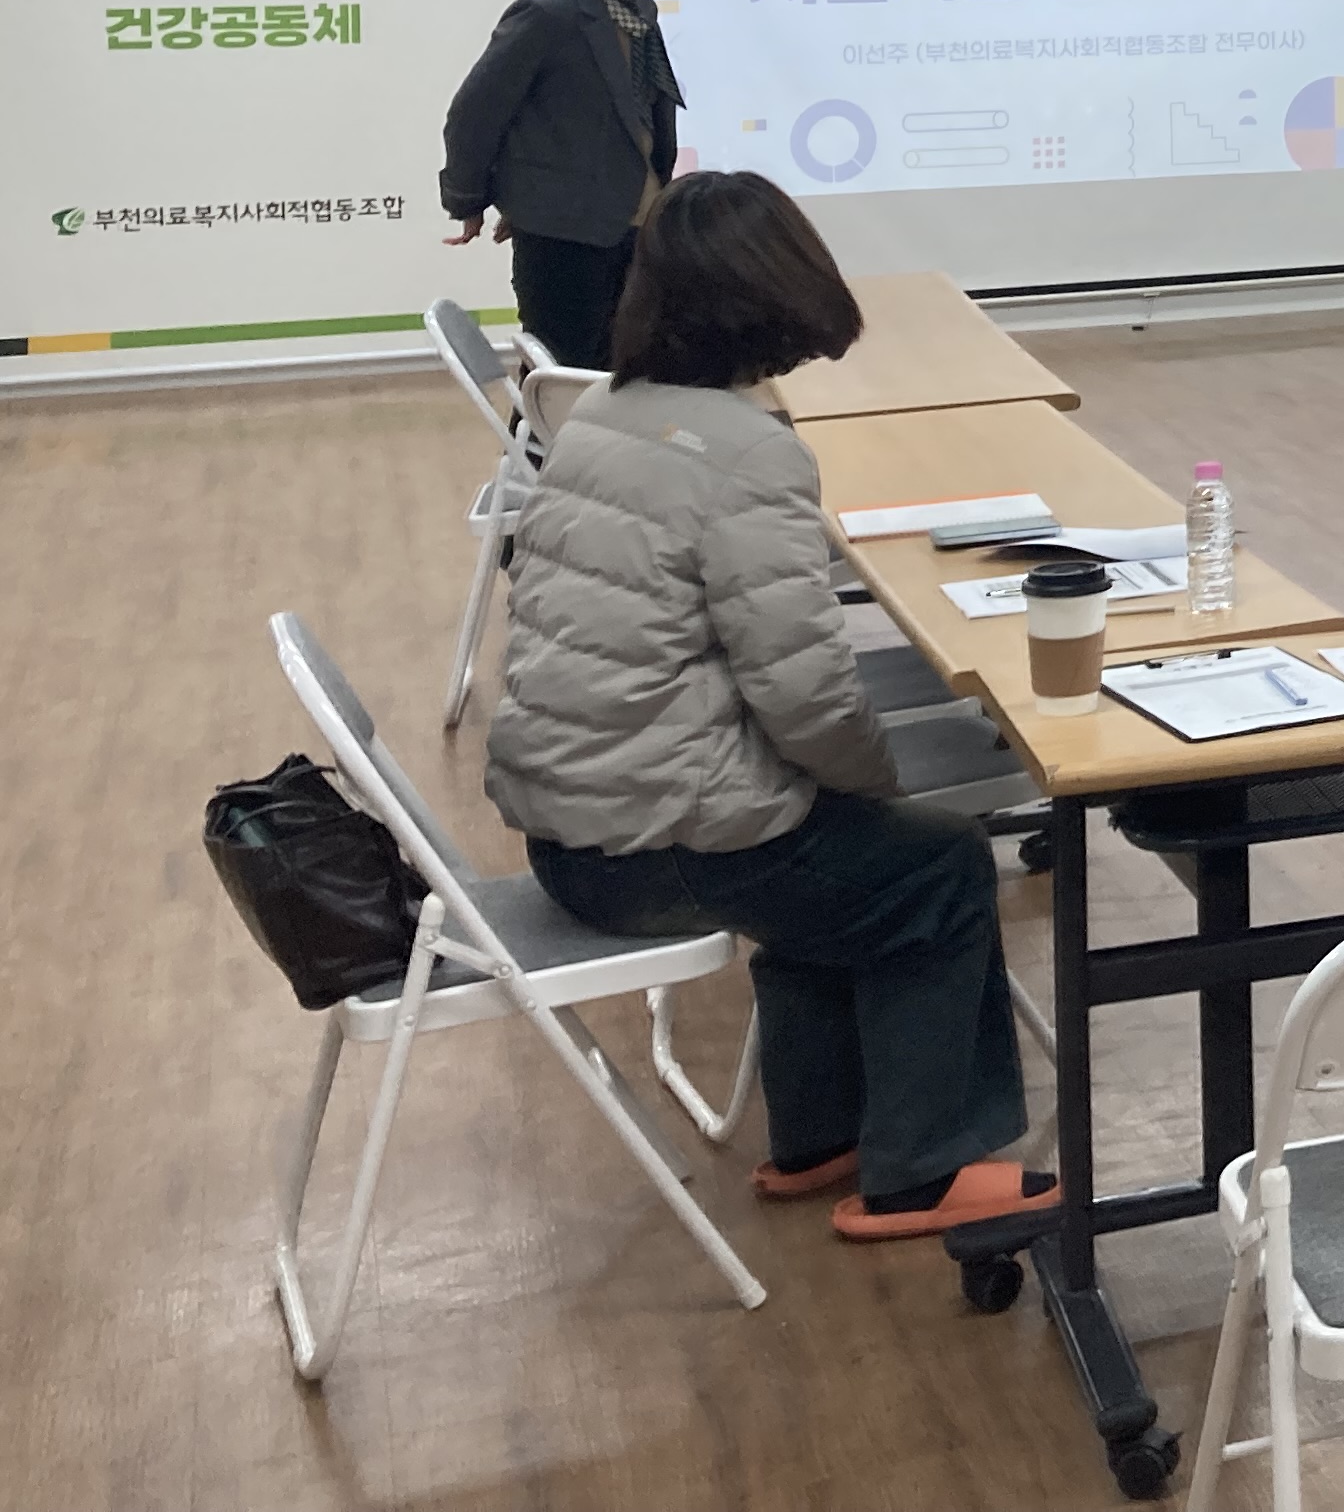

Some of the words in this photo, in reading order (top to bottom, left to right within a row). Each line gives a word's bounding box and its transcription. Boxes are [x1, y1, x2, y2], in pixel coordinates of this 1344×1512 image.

[105, 2, 362, 51] 건강공동체
[842, 42, 910, 66] 이선주
[915, 33, 1208, 65] (부천의료복지사회적협동조합
[1215, 29, 1307, 55] 전무이사)
[92, 194, 406, 233] 부천의료복지사회적협동조합
